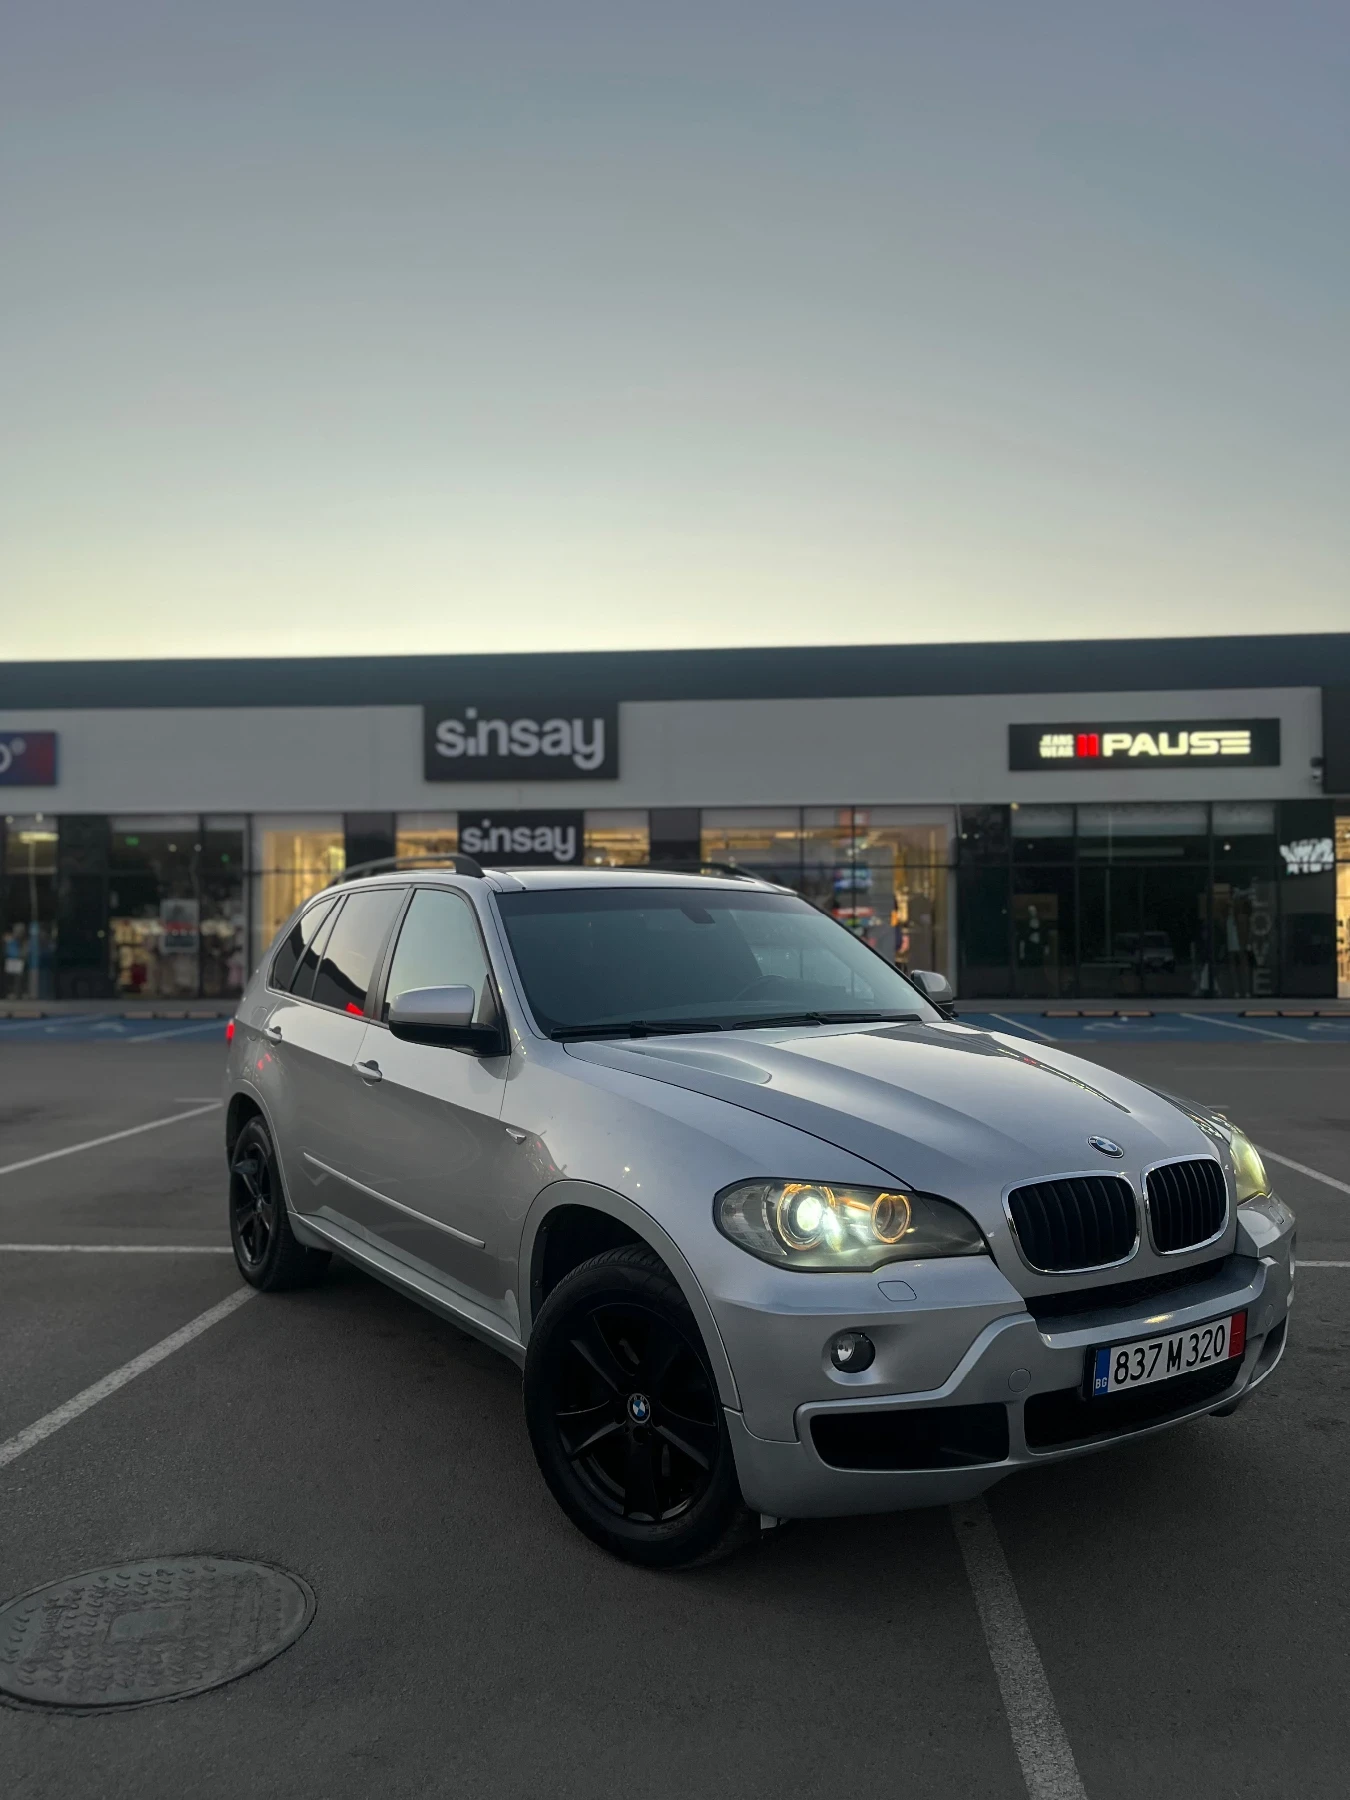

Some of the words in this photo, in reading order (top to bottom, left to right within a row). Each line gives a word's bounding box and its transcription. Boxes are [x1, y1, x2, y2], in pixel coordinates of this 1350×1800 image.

[436, 707, 605, 770] sinsay
[1103, 730, 1251, 757] PAUSE
[461, 818, 576, 862] sinsay
[1095, 1376, 1108, 1389] BG
